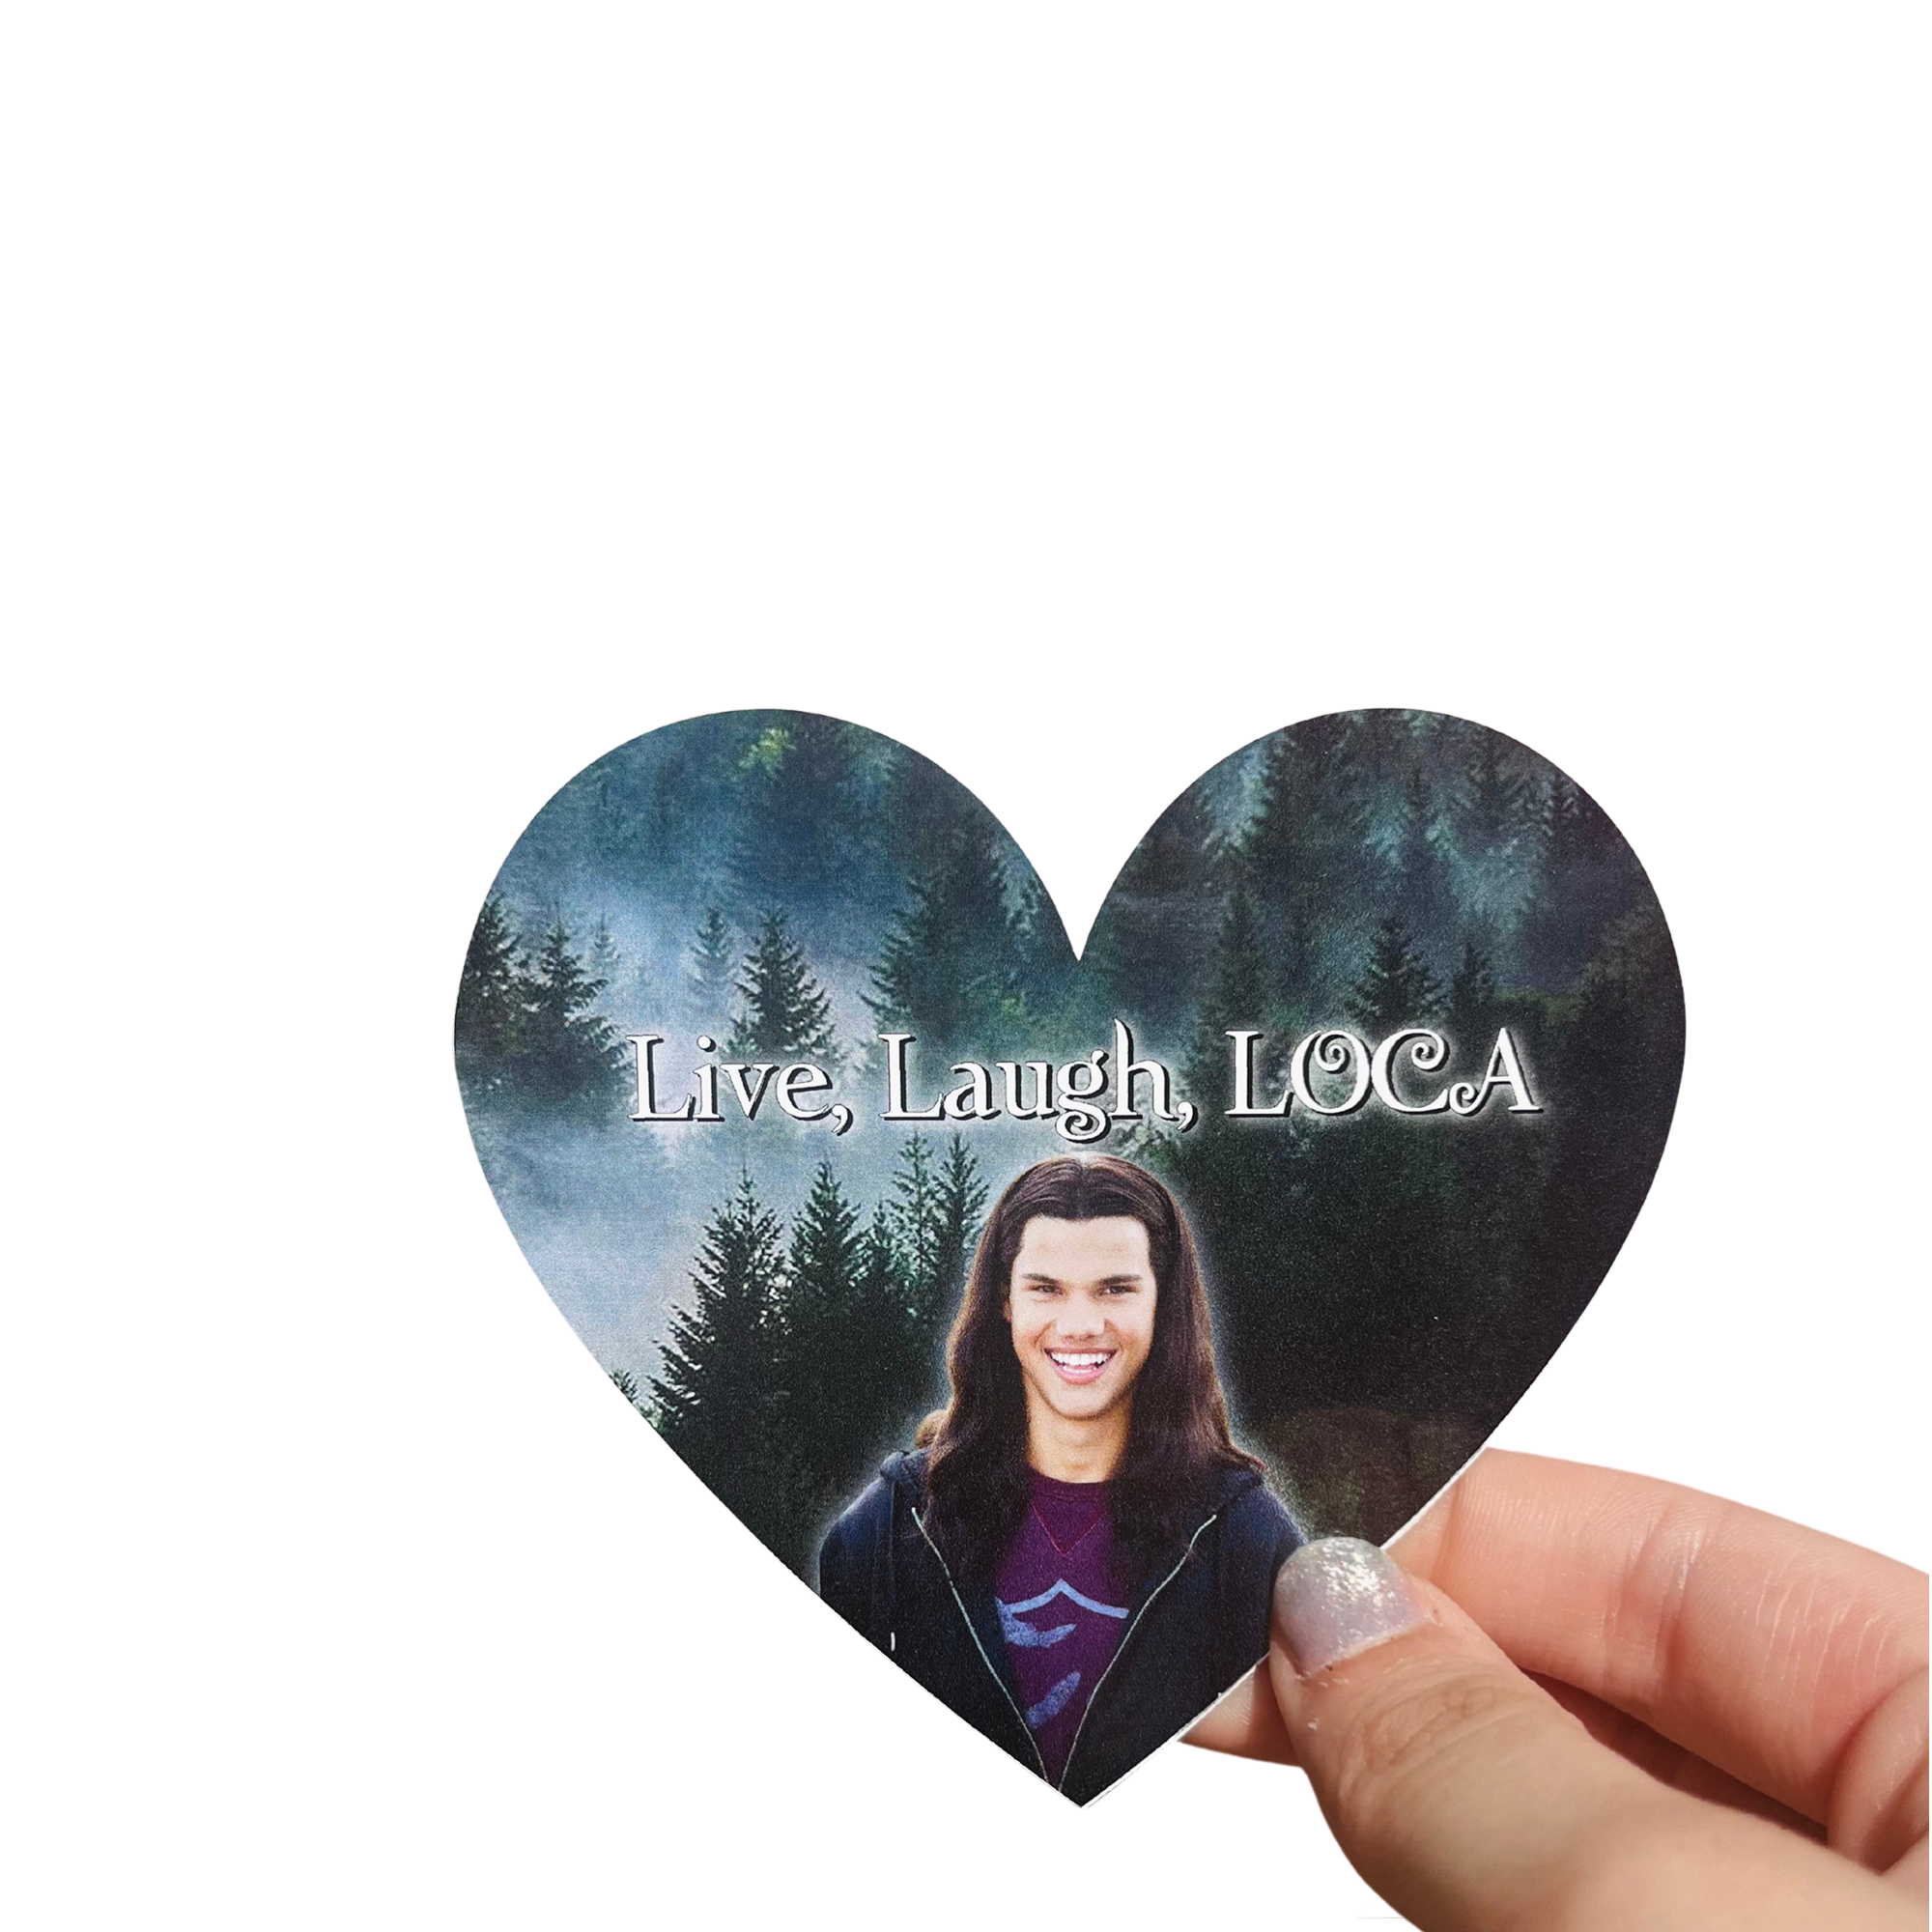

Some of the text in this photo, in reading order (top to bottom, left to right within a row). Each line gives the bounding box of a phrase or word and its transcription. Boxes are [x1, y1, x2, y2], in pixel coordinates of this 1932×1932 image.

[626, 1018, 1544, 1143] Live, Laugh, LOCA
